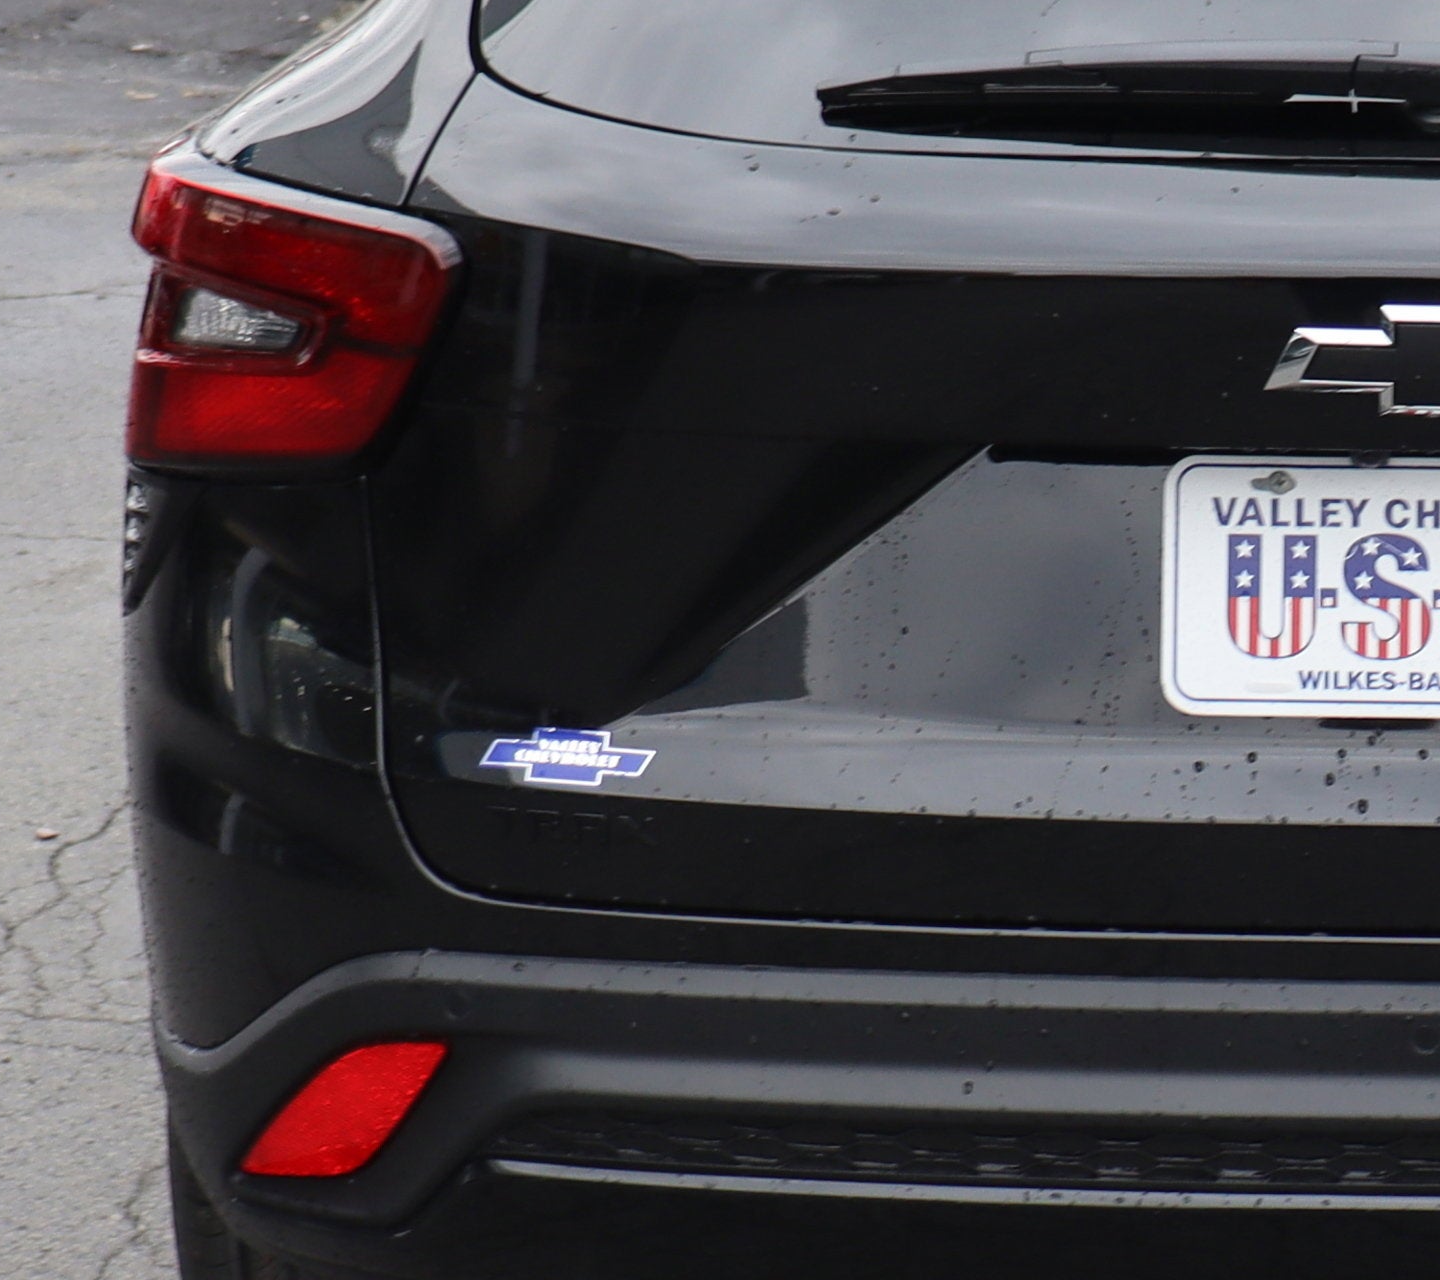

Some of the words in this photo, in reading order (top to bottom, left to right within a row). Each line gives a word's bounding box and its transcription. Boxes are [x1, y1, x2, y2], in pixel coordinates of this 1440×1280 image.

[1212, 496, 1371, 528] VALLEY
[537, 738, 603, 754] VALLEY
[514, 748, 622, 769] CHEVROLET
